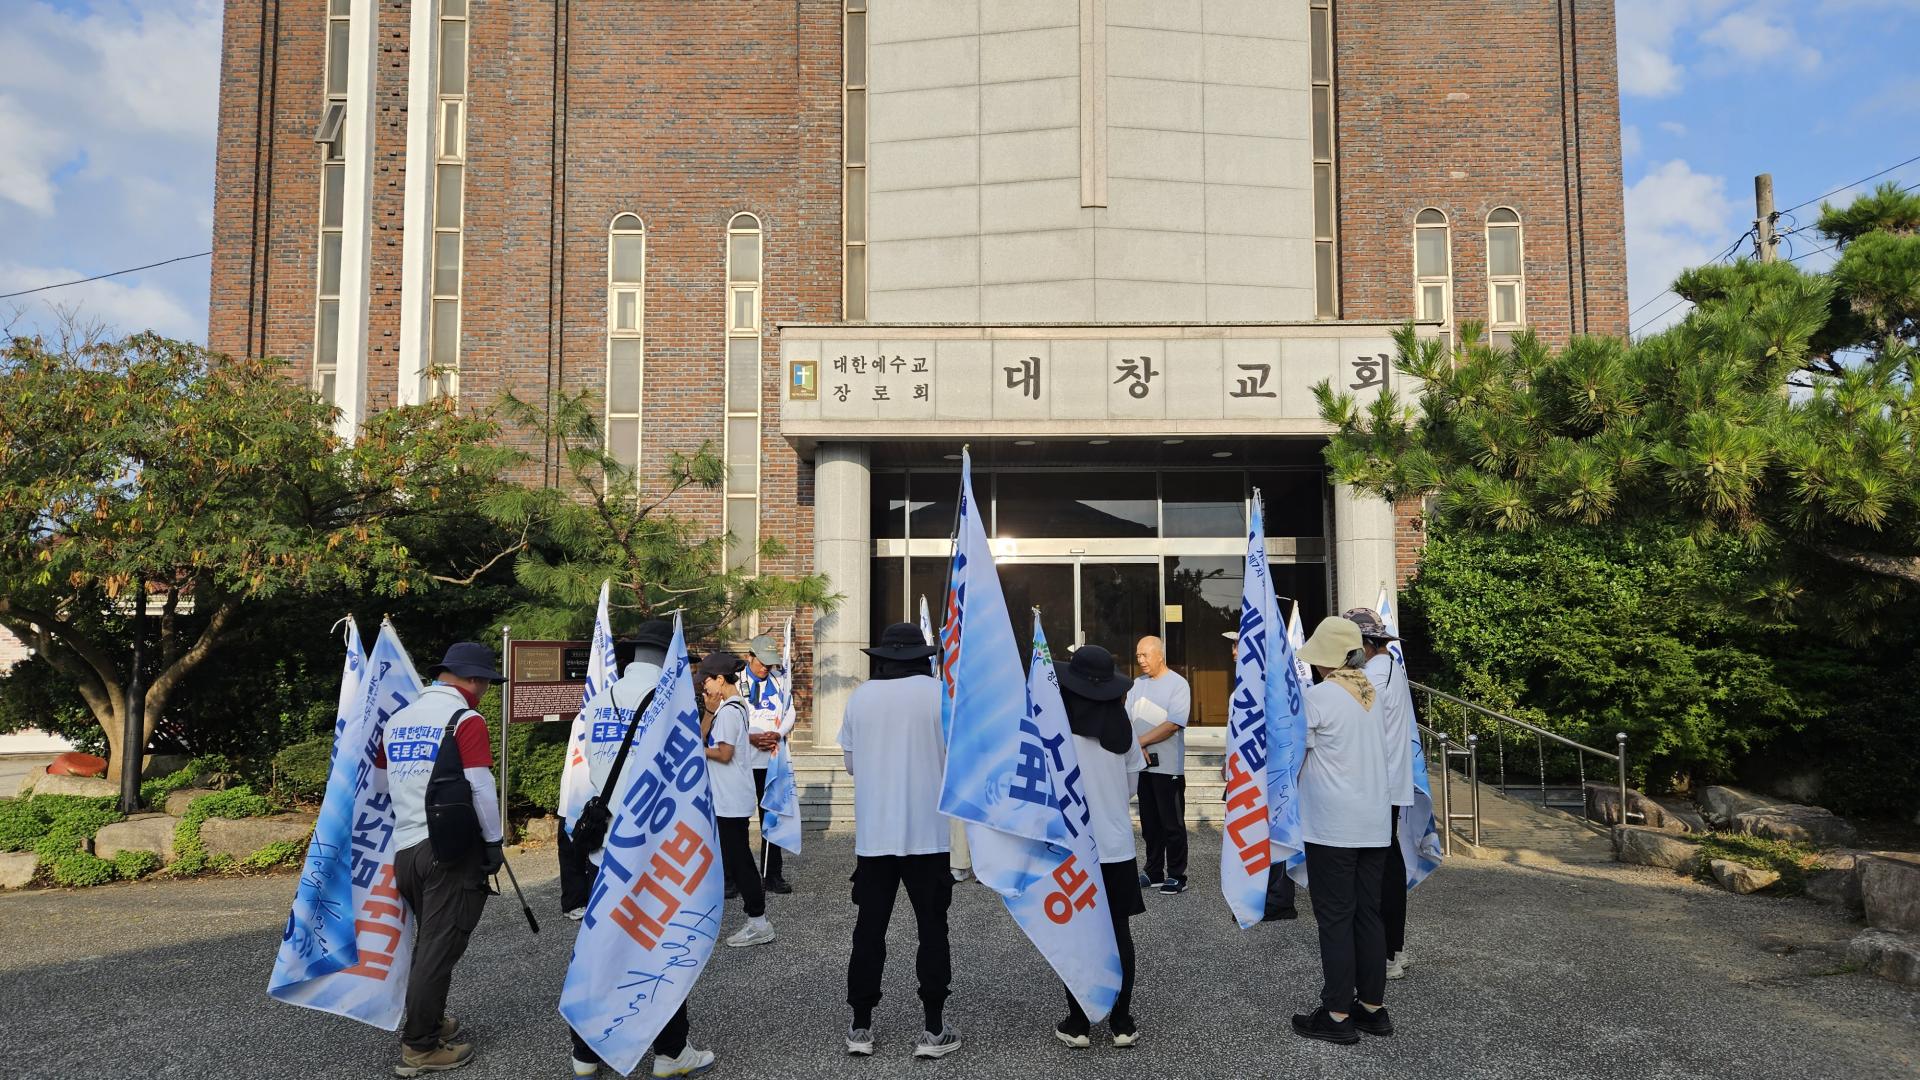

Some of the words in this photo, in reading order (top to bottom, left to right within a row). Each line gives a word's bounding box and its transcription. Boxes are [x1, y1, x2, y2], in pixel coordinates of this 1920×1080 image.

[833, 355, 929, 374] 대한예수교
[1003, 353, 1390, 400] 대창교회
[833, 383, 929, 402] 장로회
